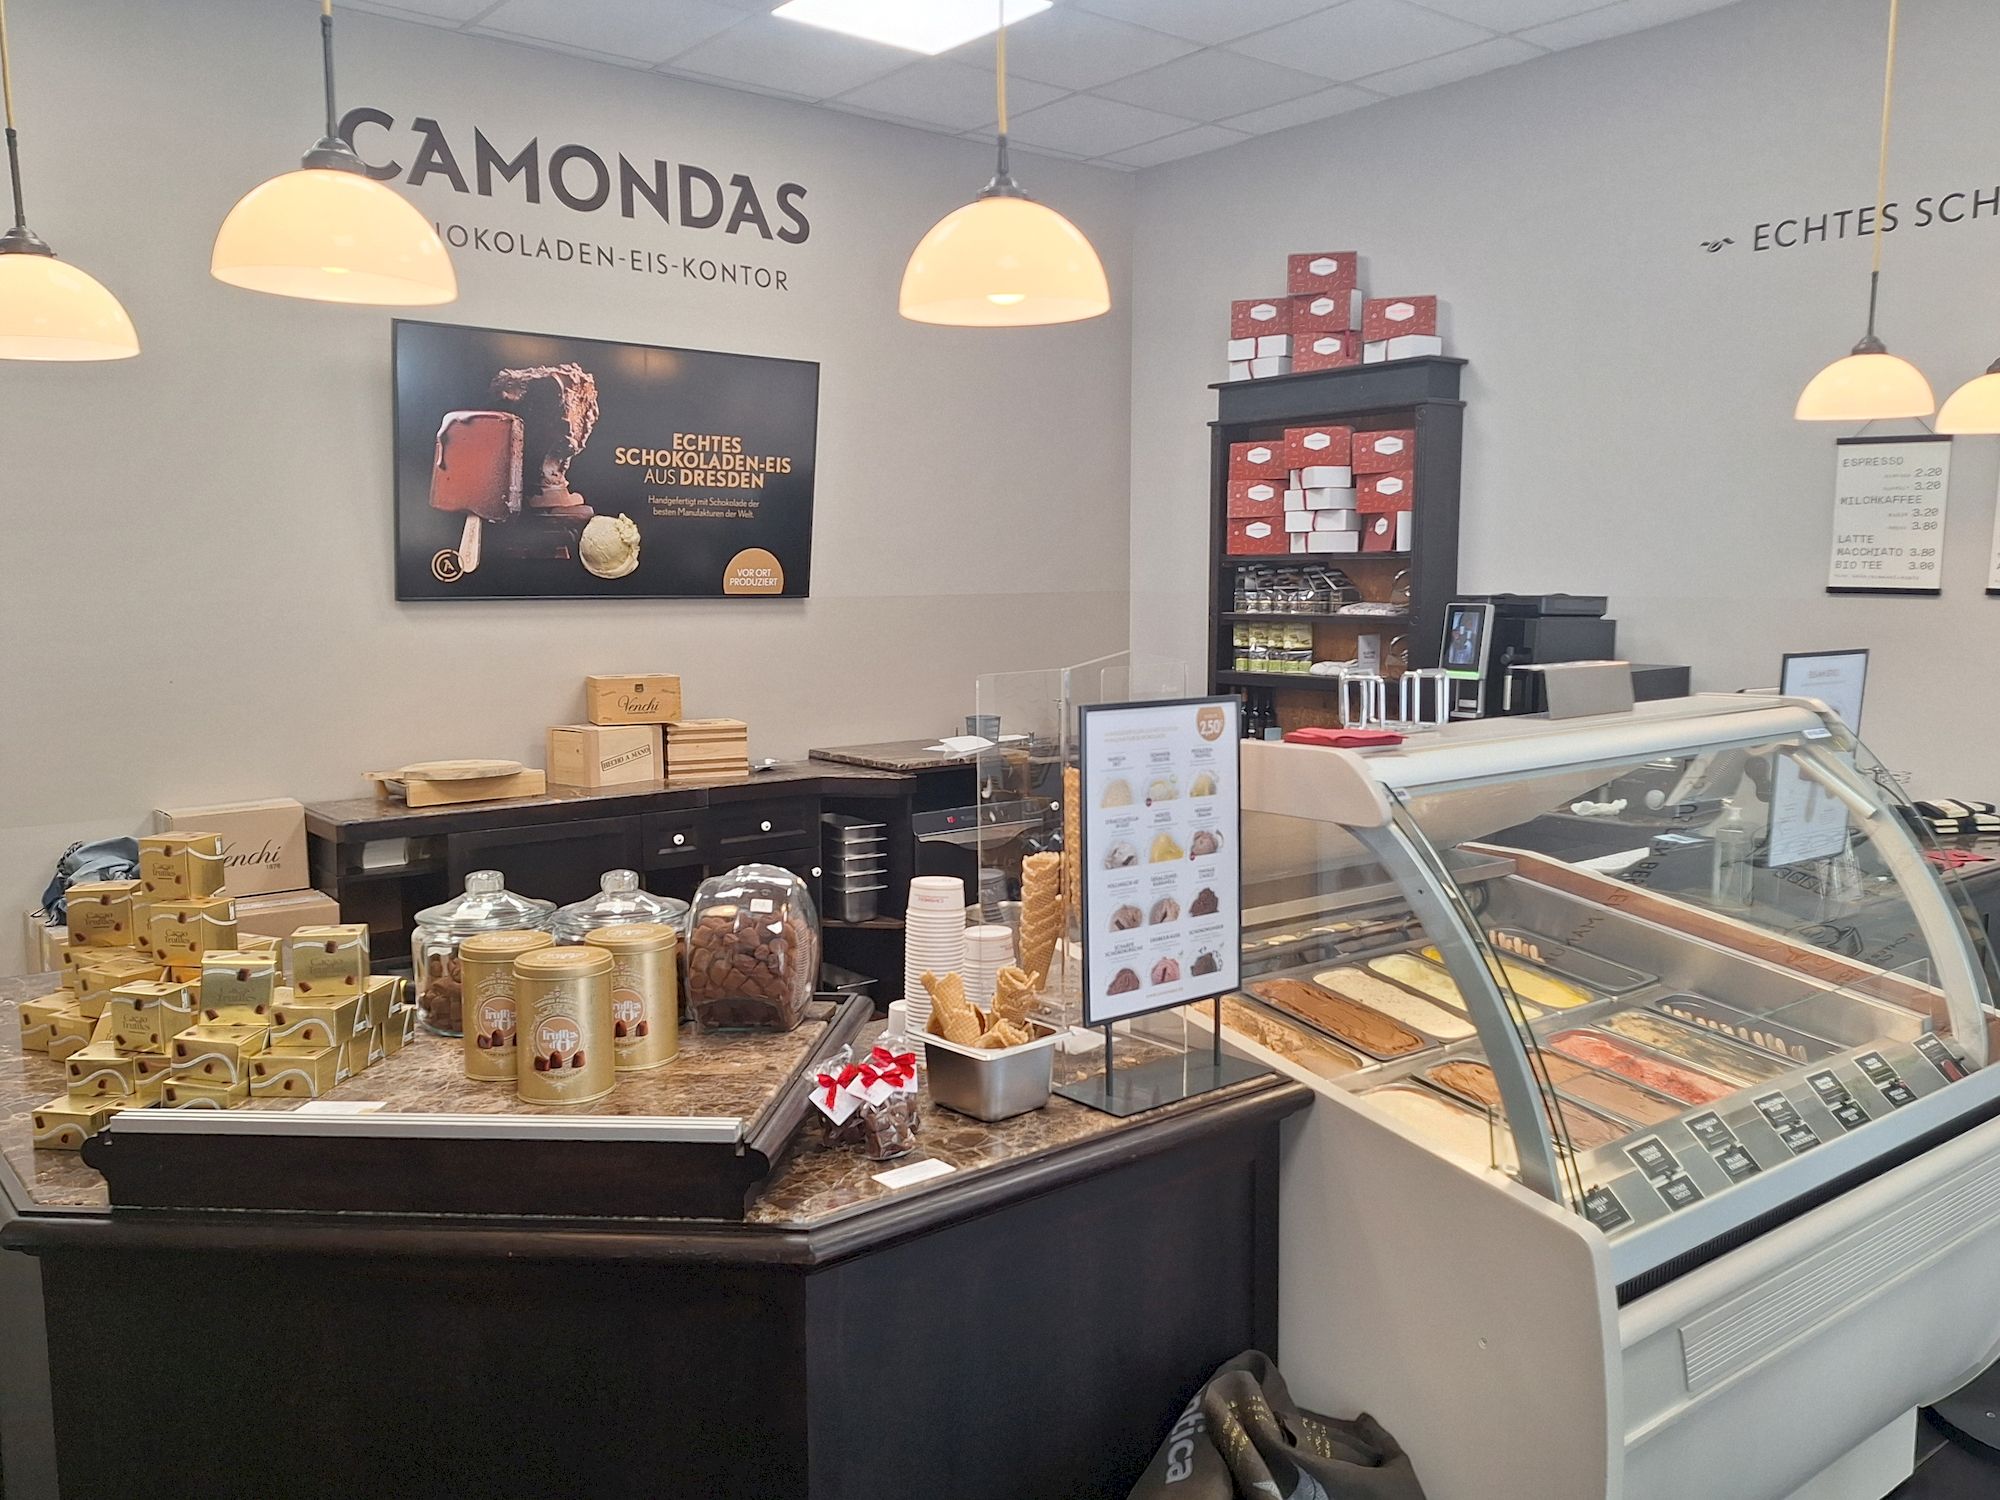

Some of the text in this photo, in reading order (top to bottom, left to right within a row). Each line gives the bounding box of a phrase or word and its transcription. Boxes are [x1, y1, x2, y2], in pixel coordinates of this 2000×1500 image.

[338, 107, 812, 245] CAMONDAS
[1753, 185, 2000, 251] ECHTES SCH
[672, 432, 742, 453] ECHTES
[615, 447, 791, 473] SCHOKOLADEN-EIS
[1843, 456, 1904, 467] ESPRESSO
[1915, 467, 1942, 478] 2.20
[644, 469, 765, 489] AUS DRESDEN
[1914, 480, 1942, 490] 3.20
[648, 495, 760, 508] Handgefertigt mit Schokolade der
[1840, 495, 1922, 505] MILCHKAFFEE
[653, 506, 676, 516] besten
[678, 507, 724, 517] Manufakturen
[725, 509, 737, 518] der
[1912, 508, 1939, 517] 3.20
[1912, 521, 1938, 530] 3.80
[1838, 535, 1874, 544] LATTE
[1837, 547, 1935, 557] MACCHIATO 3.80
[1835, 561, 1935, 570] BIO TEE 3.00
[737, 568, 772, 577] VOR ORT
[729, 577, 778, 586] PRODUZIERT
[617, 694, 660, 712] Venchi
